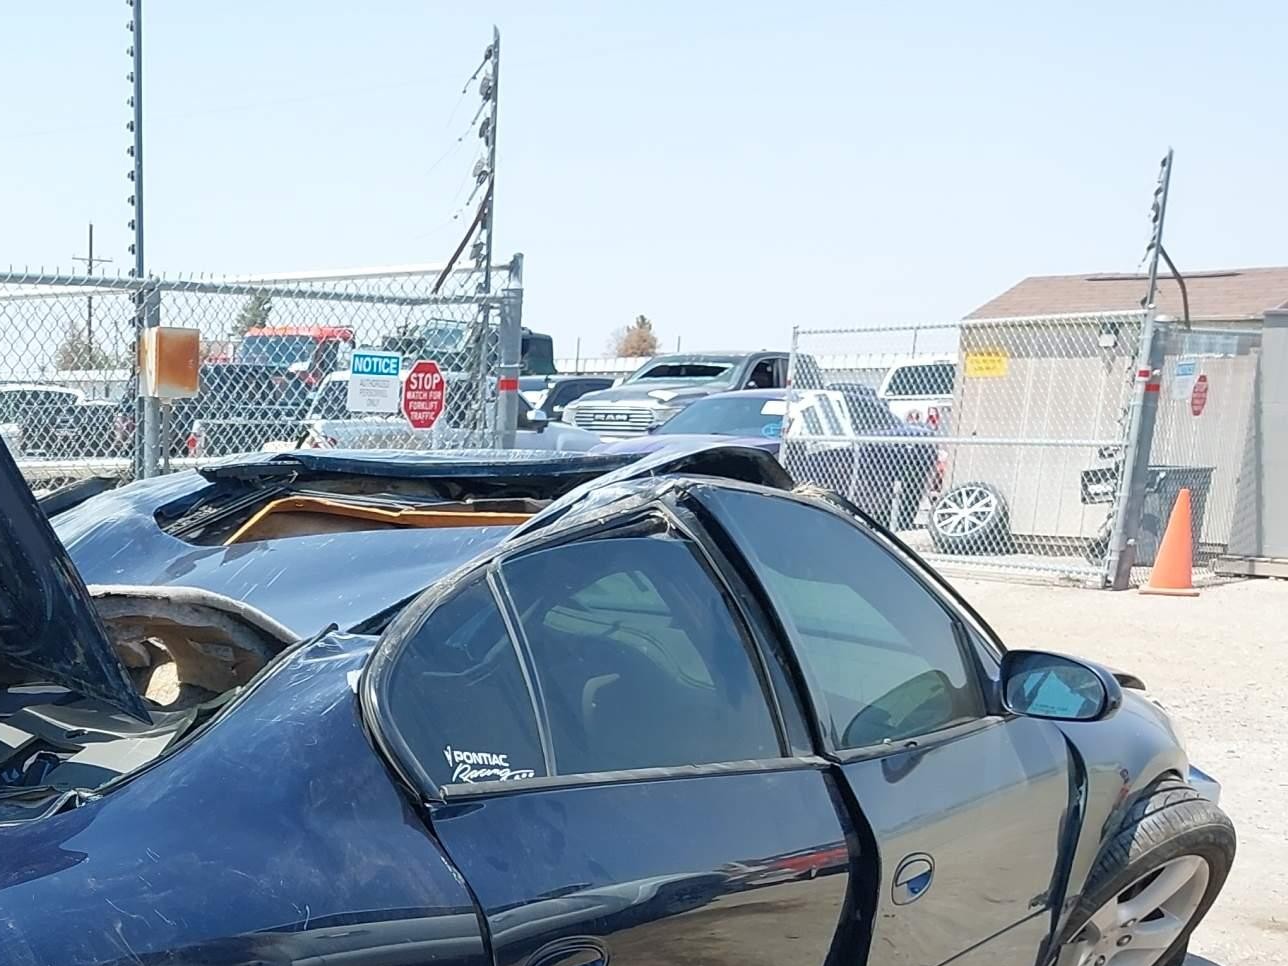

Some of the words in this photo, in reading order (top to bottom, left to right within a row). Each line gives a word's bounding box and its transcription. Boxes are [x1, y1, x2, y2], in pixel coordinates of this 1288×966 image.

[354, 356, 397, 374] NOTICE
[410, 373, 441, 390] STOP
[406, 390, 426, 400] WATCH
[428, 390, 442, 400] FOR
[408, 401, 438, 410] FORKLIFT
[410, 411, 436, 420] TRAFFIC
[453, 750, 510, 767] PONTIAC
